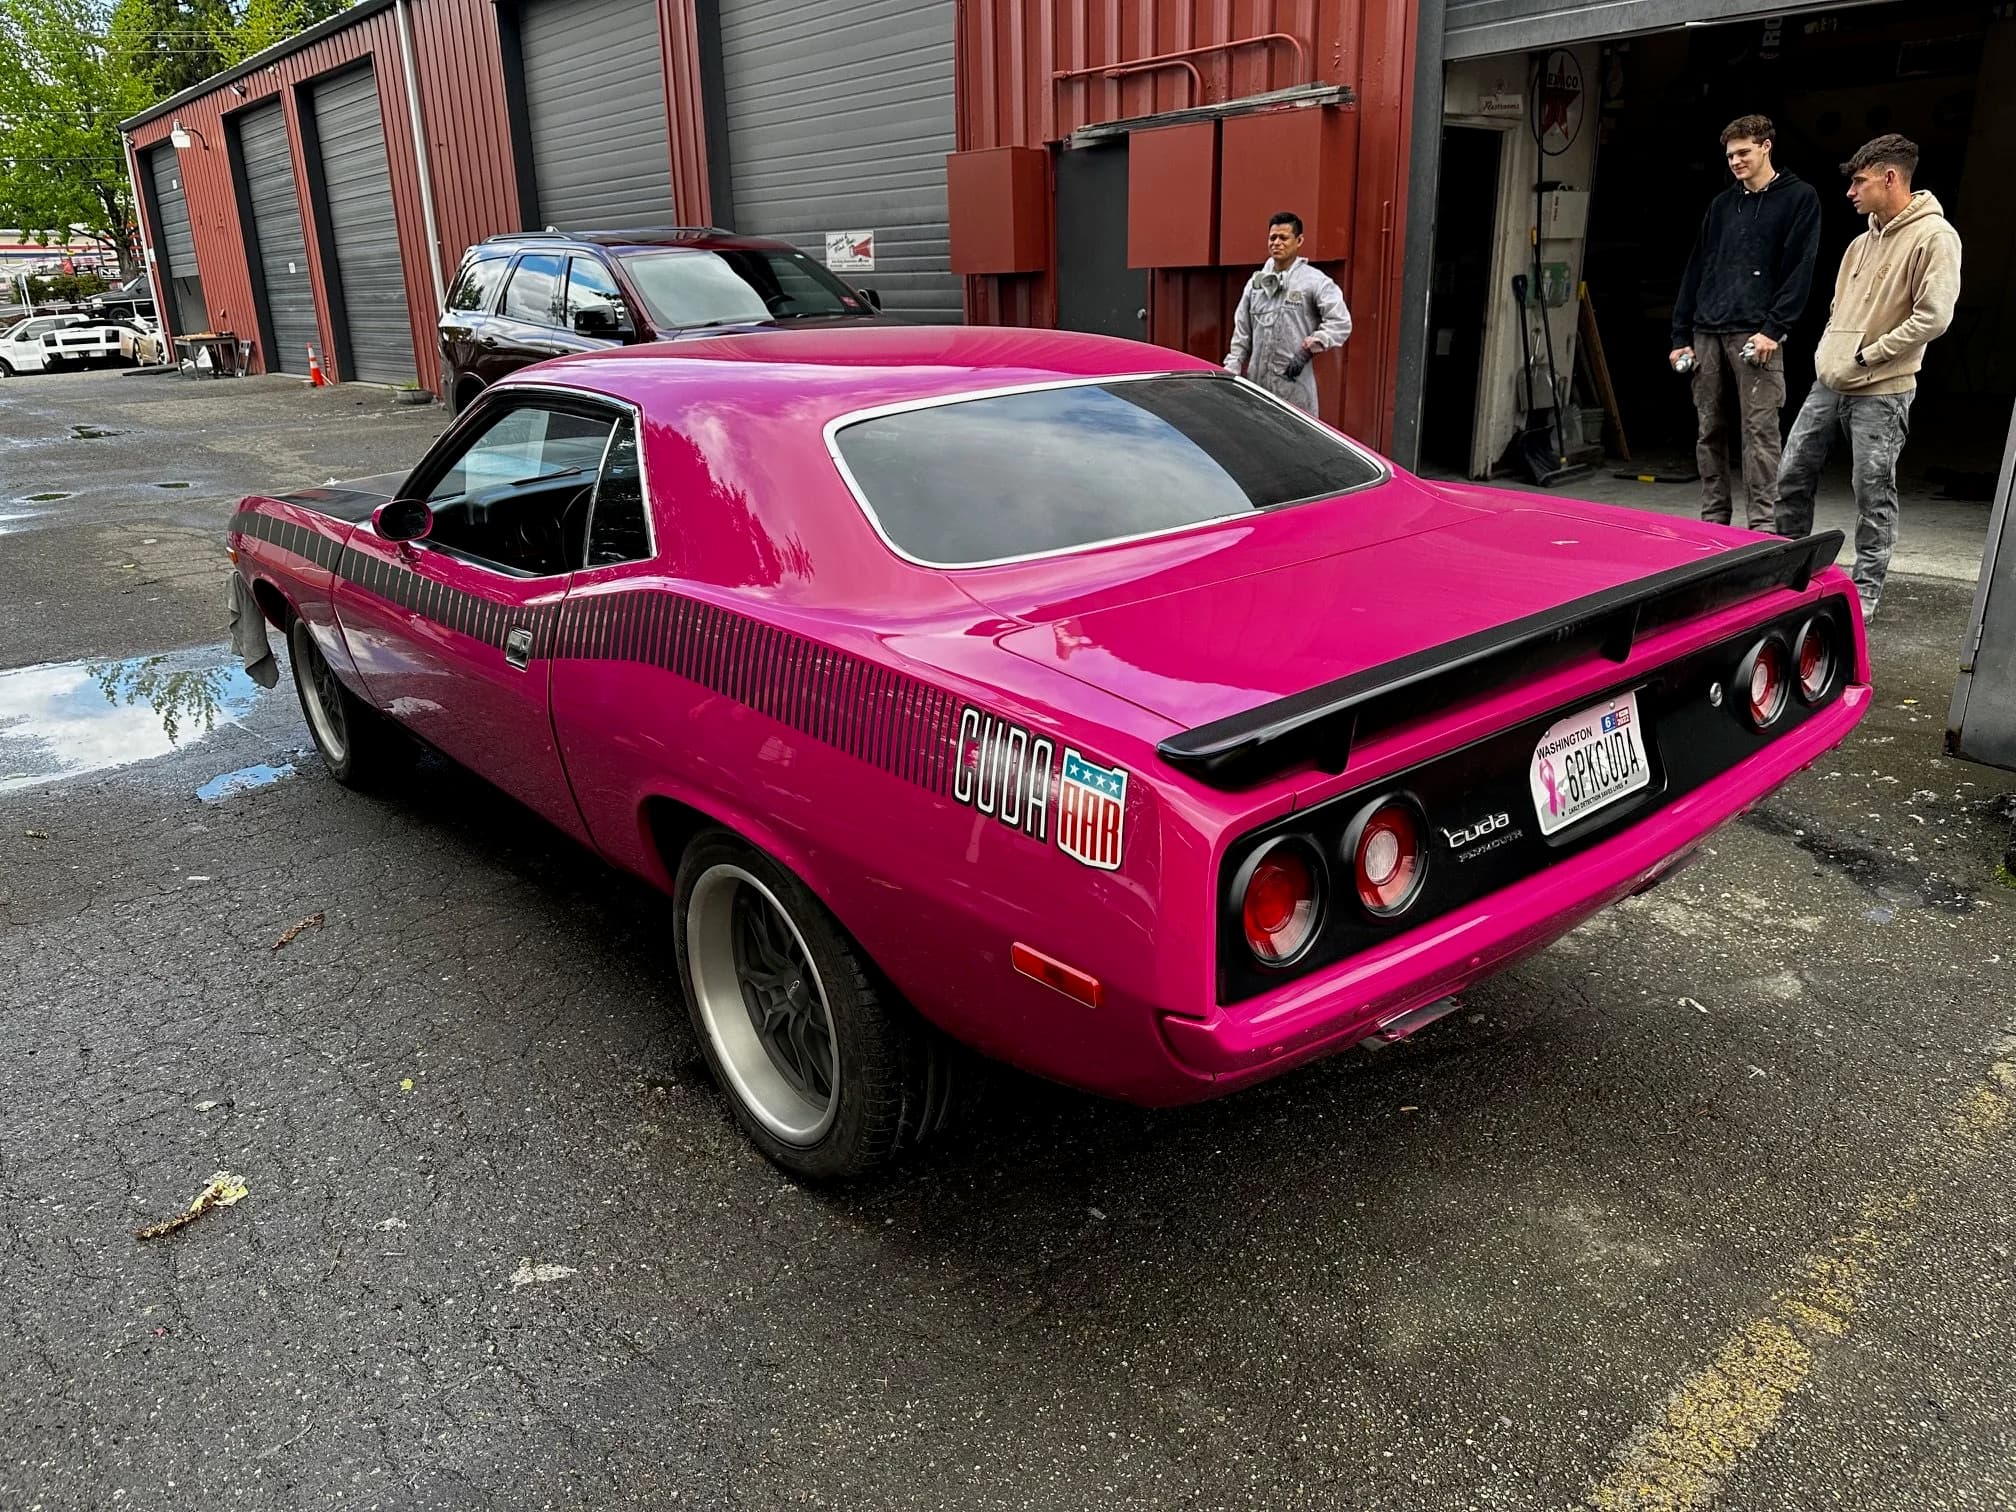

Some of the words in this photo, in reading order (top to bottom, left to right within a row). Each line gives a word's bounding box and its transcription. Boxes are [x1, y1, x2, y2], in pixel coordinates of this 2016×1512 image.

[1544, 73, 1579, 89] EXACO
[953, 706, 1054, 841] CUDA
[1536, 726, 1593, 760] WASHINGTON
[1565, 727, 1640, 802] 6PKCUDA
[1060, 781, 1121, 865] AAR
